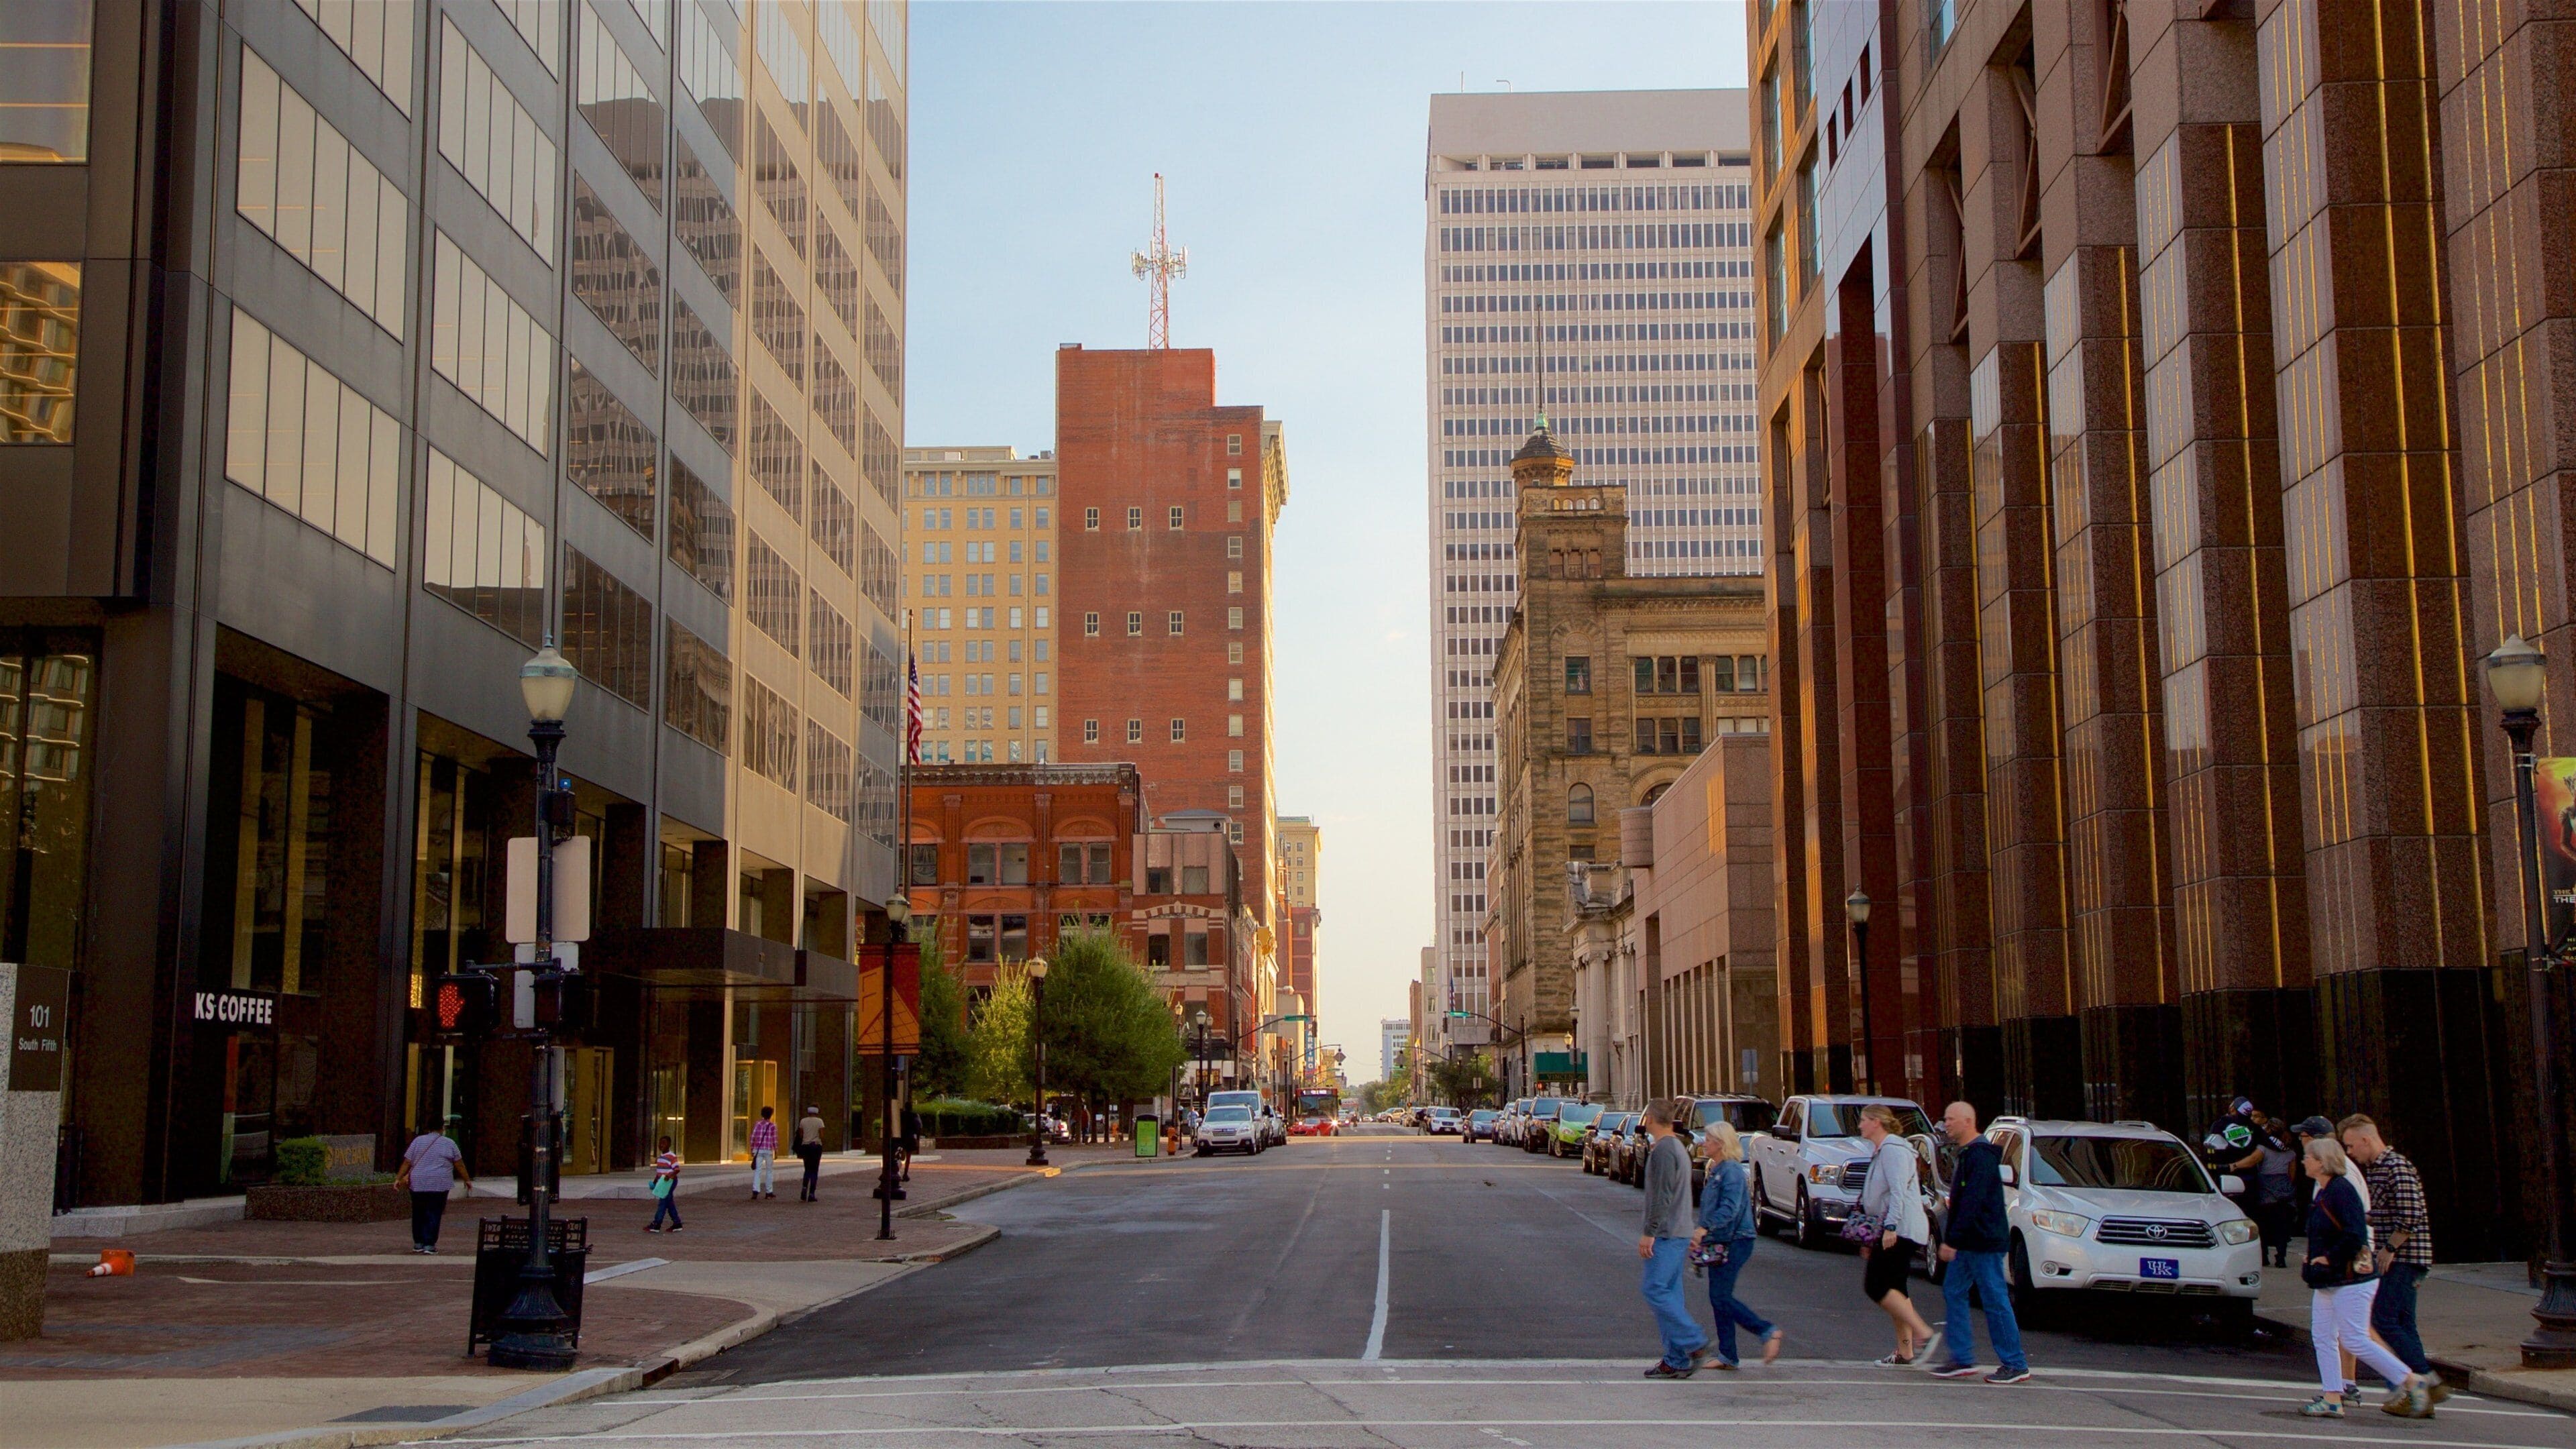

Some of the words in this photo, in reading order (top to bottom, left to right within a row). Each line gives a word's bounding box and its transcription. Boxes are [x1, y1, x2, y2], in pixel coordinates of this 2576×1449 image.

[30, 1005, 50, 1028] 101
[195, 992, 215, 1020] KS
[218, 994, 272, 1024] COFFEE
[18, 1037, 38, 1051] South
[42, 1038, 57, 1052] Fifth
[2147, 1260, 2172, 1276] UK
